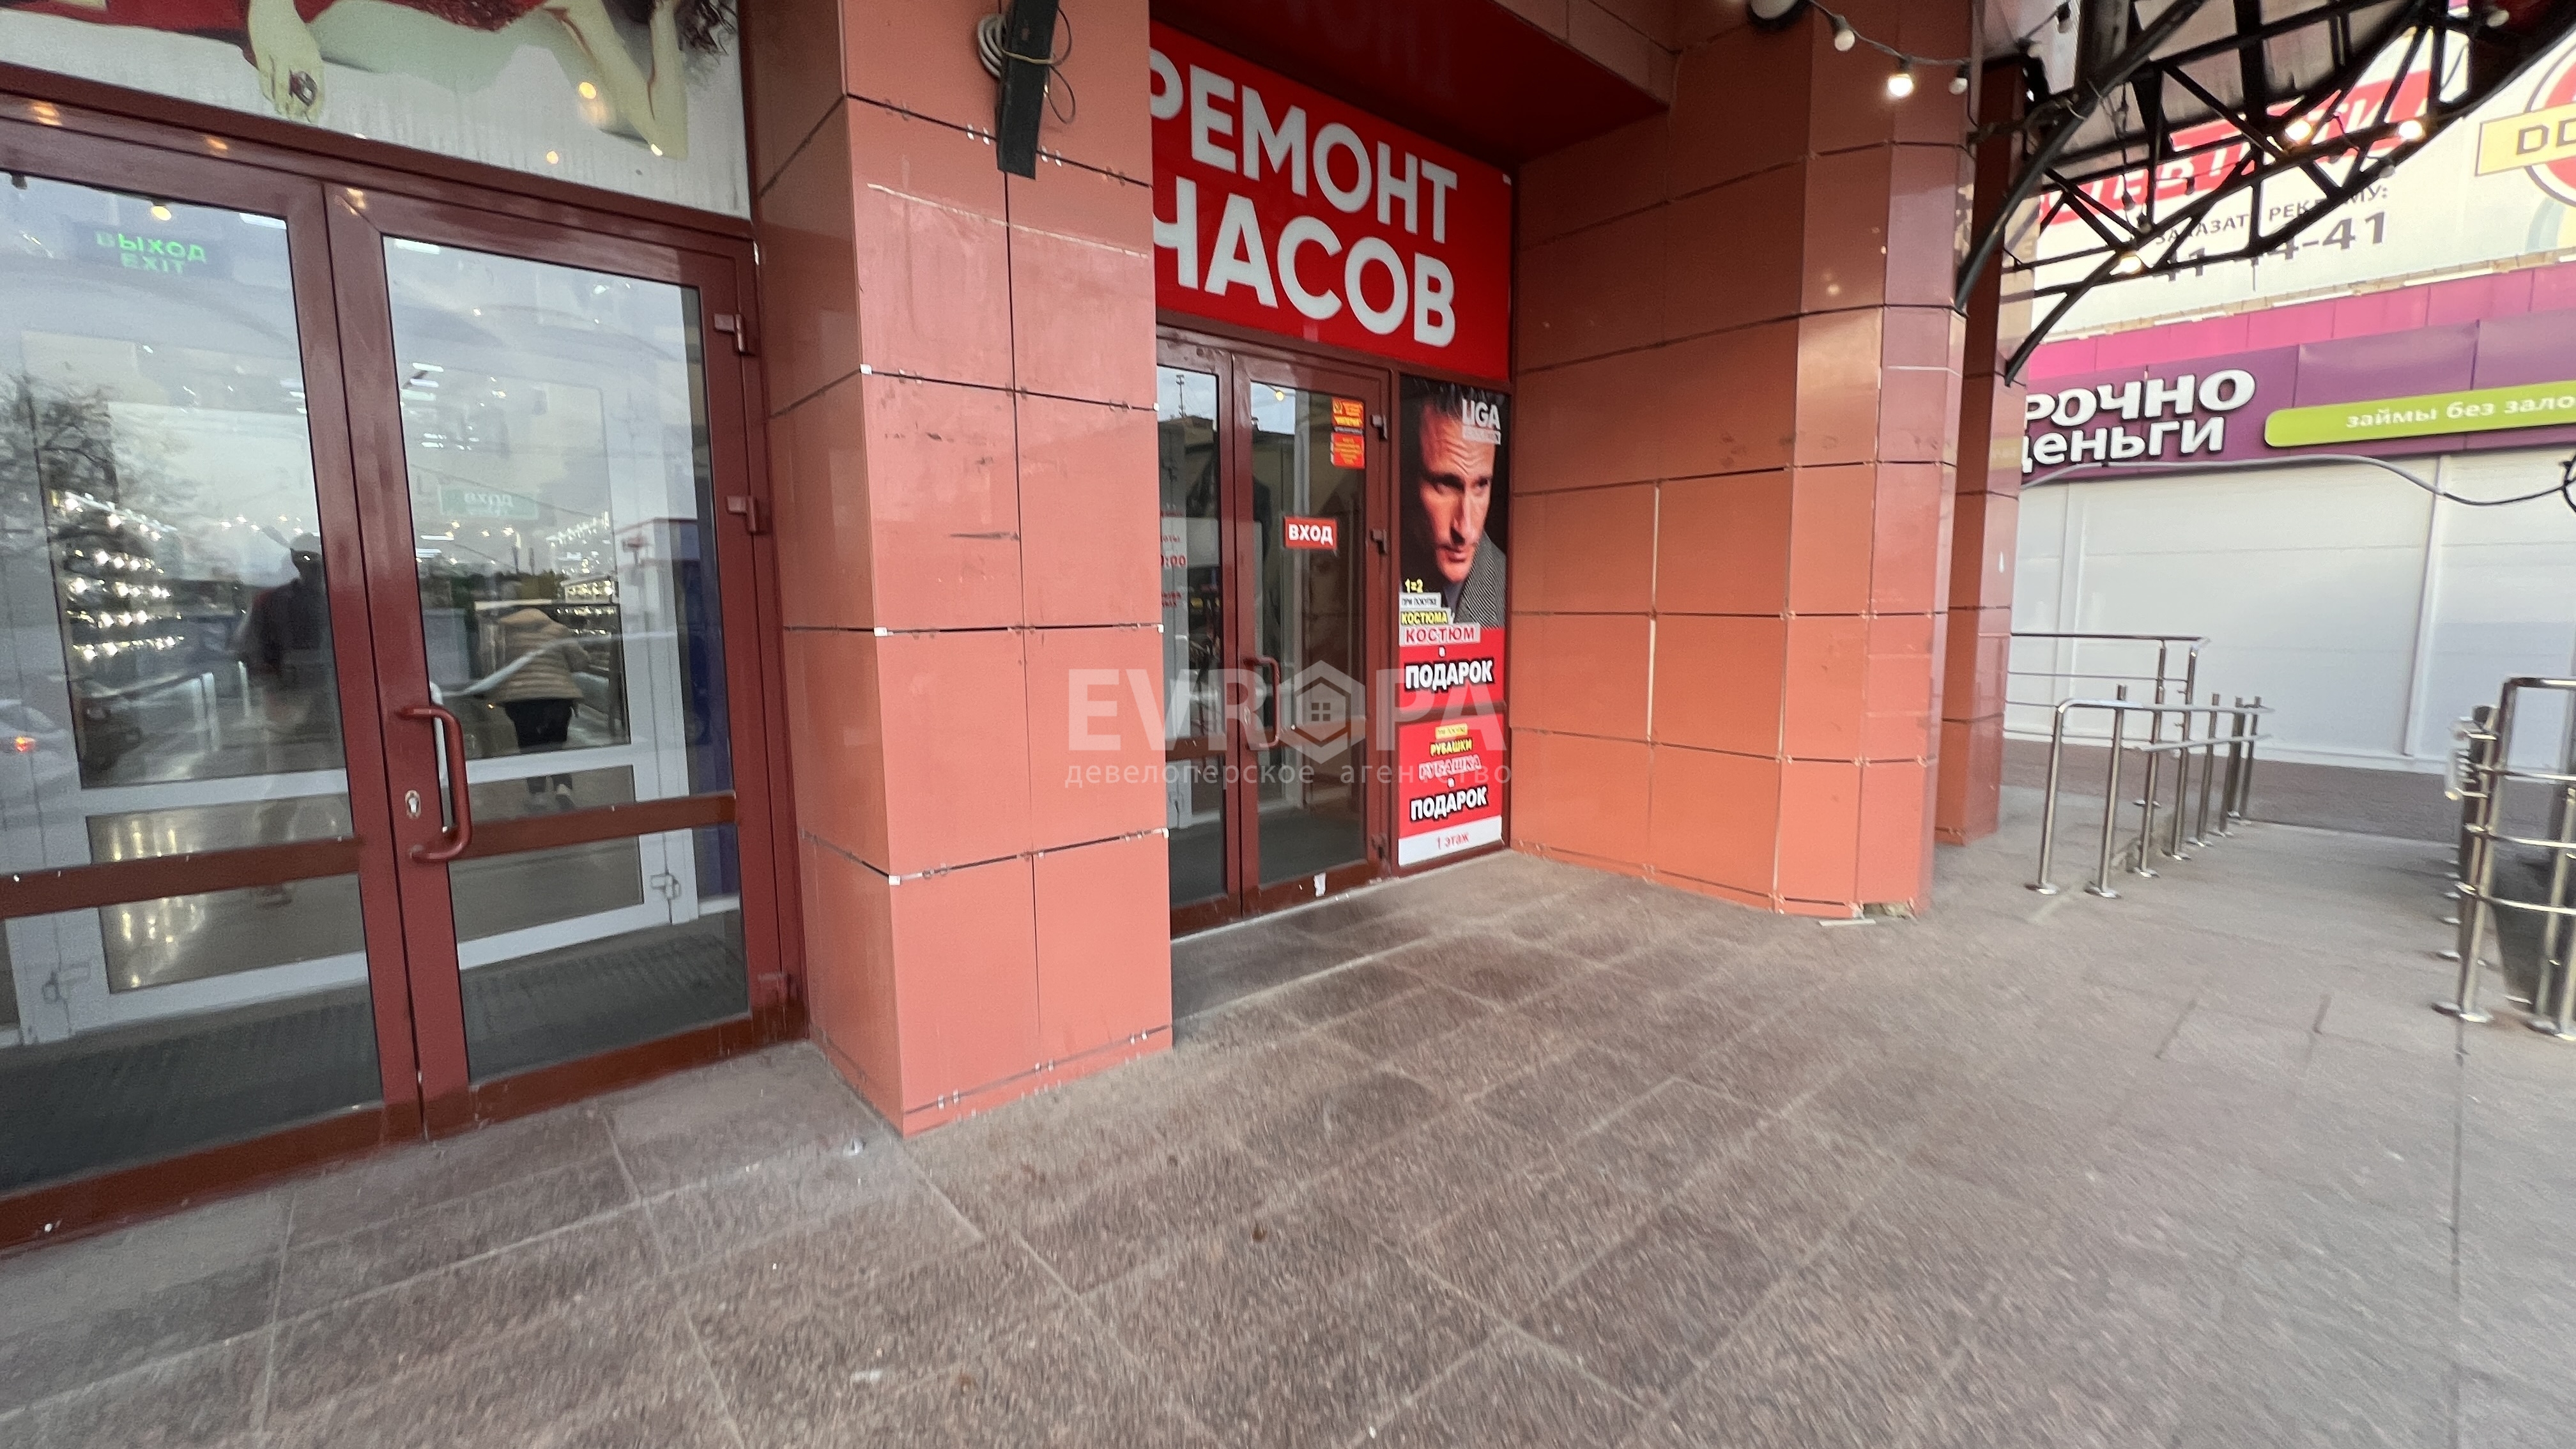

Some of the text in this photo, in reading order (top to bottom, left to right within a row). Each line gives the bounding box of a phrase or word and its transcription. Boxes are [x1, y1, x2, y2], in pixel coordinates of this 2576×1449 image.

[1150, 45, 1457, 243] РЕМОНТ
[2156, 184, 2388, 245] ЗААЗАТ РЕКМУ:
[120, 252, 184, 273] EXIT
[1153, 176, 1455, 347] ЧАСОВ
[2346, 408, 2438, 428] займы
[2446, 401, 2495, 419] без
[1288, 523, 1333, 546] ВХОД
[1406, 627, 1475, 644] КОСТЮМ
[1406, 660, 1493, 690] ПОДАРОК
[1430, 738, 1472, 756] РУБАШКИ
[1411, 786, 1487, 821] ПОДАРОК
[1437, 836, 1441, 850] 1
